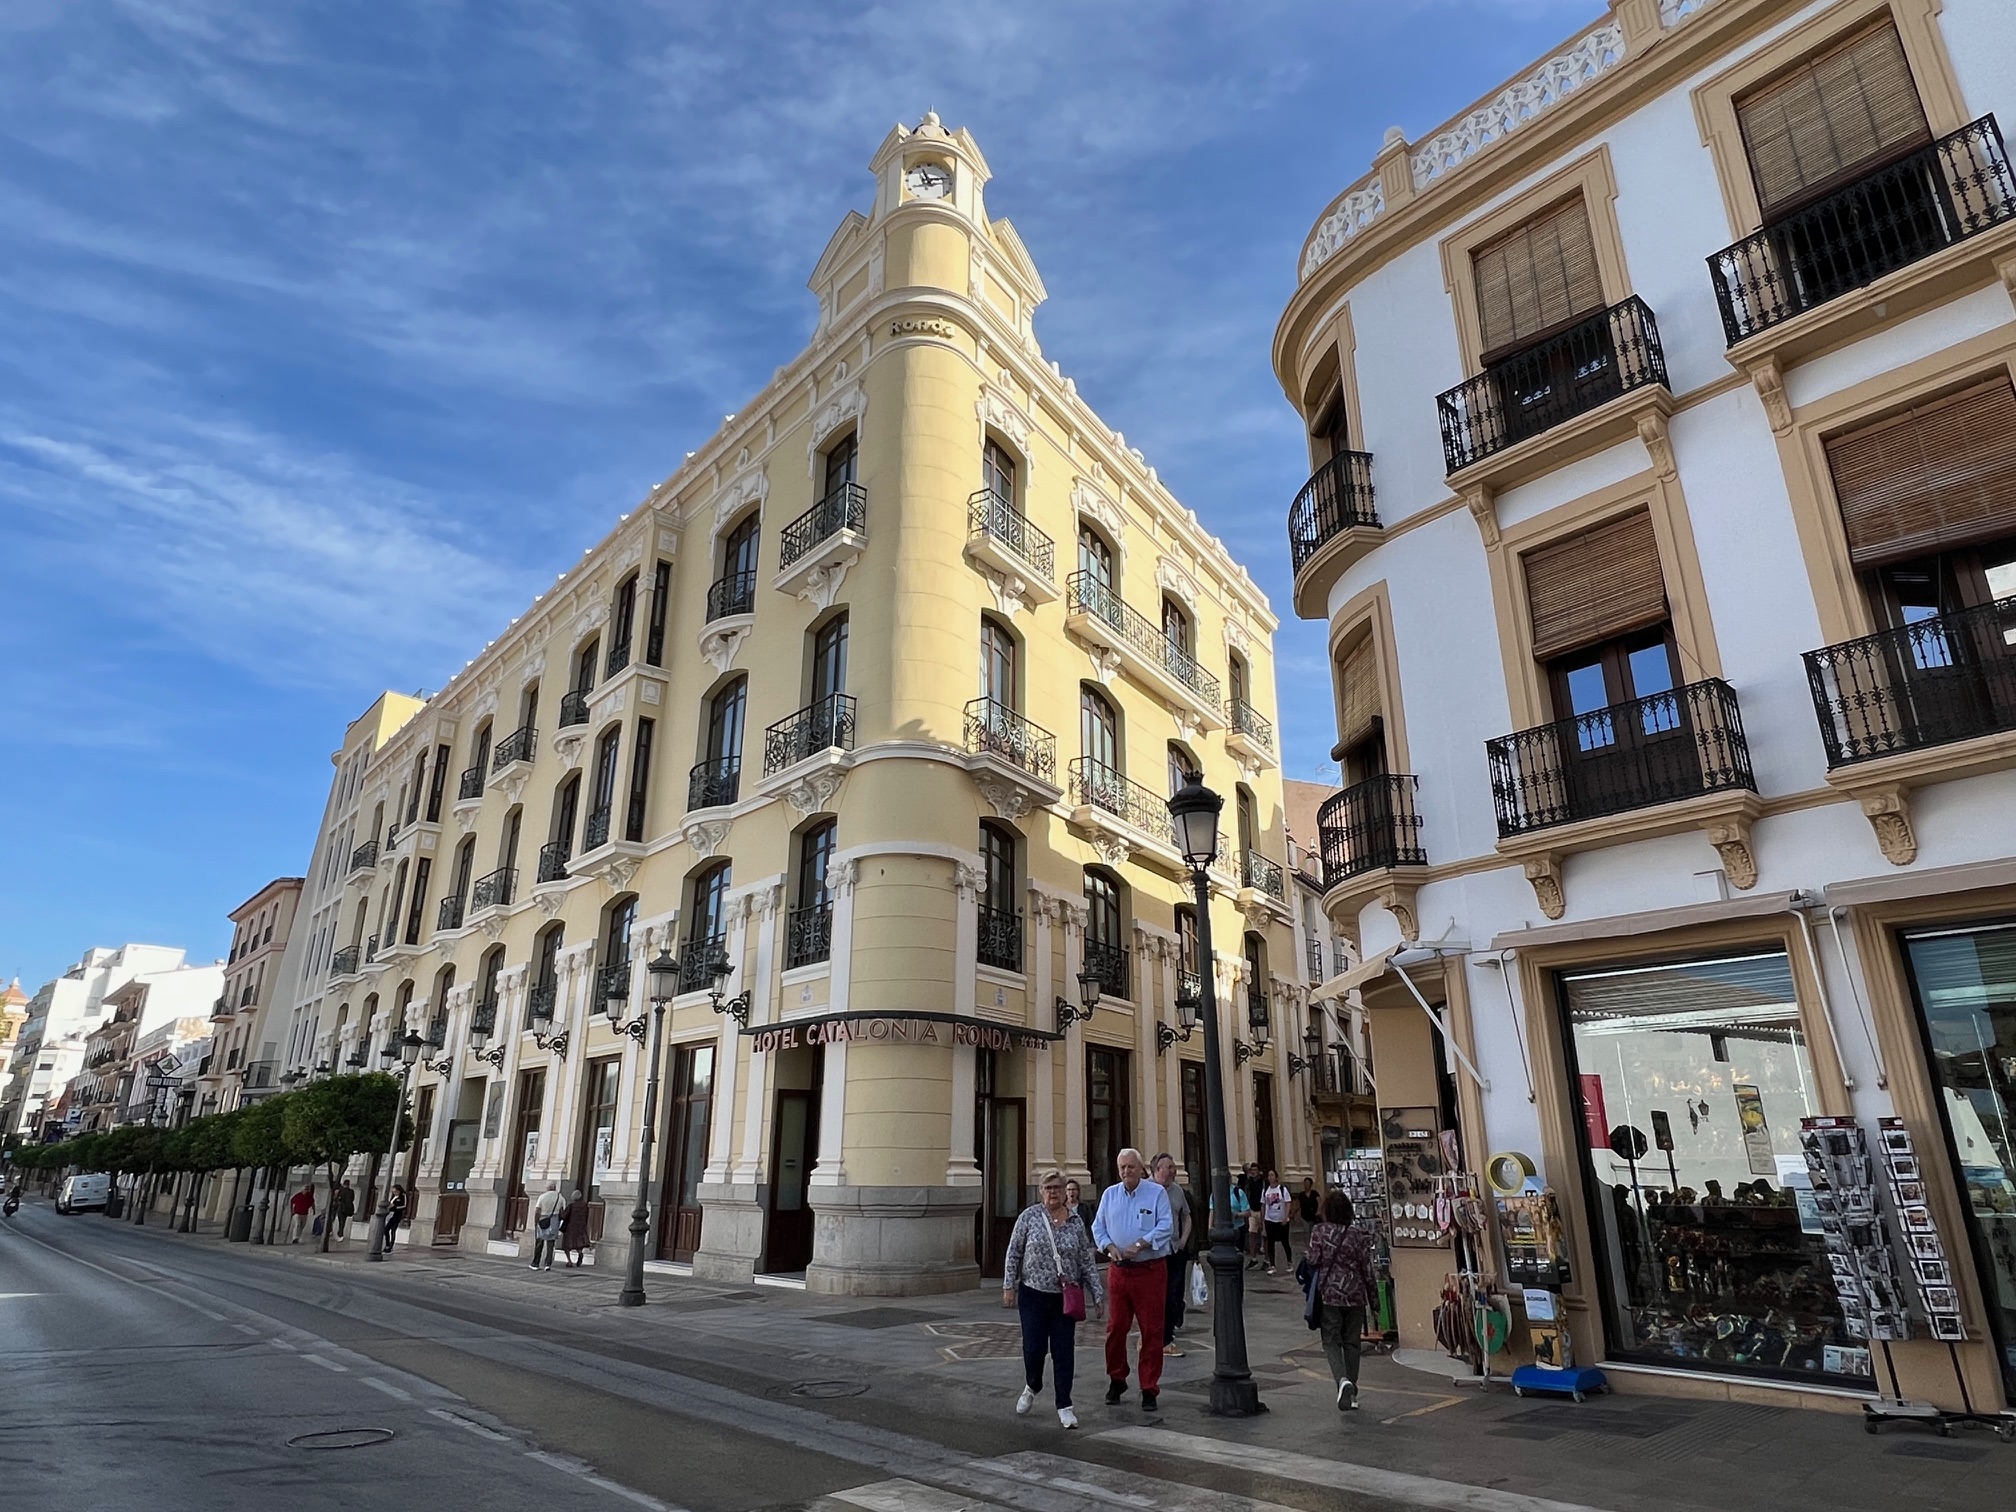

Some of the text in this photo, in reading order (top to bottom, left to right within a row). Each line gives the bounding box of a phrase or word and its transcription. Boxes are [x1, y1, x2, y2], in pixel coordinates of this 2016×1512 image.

[752, 1018, 1014, 1053] HOTEL CATALONIA RONDA
